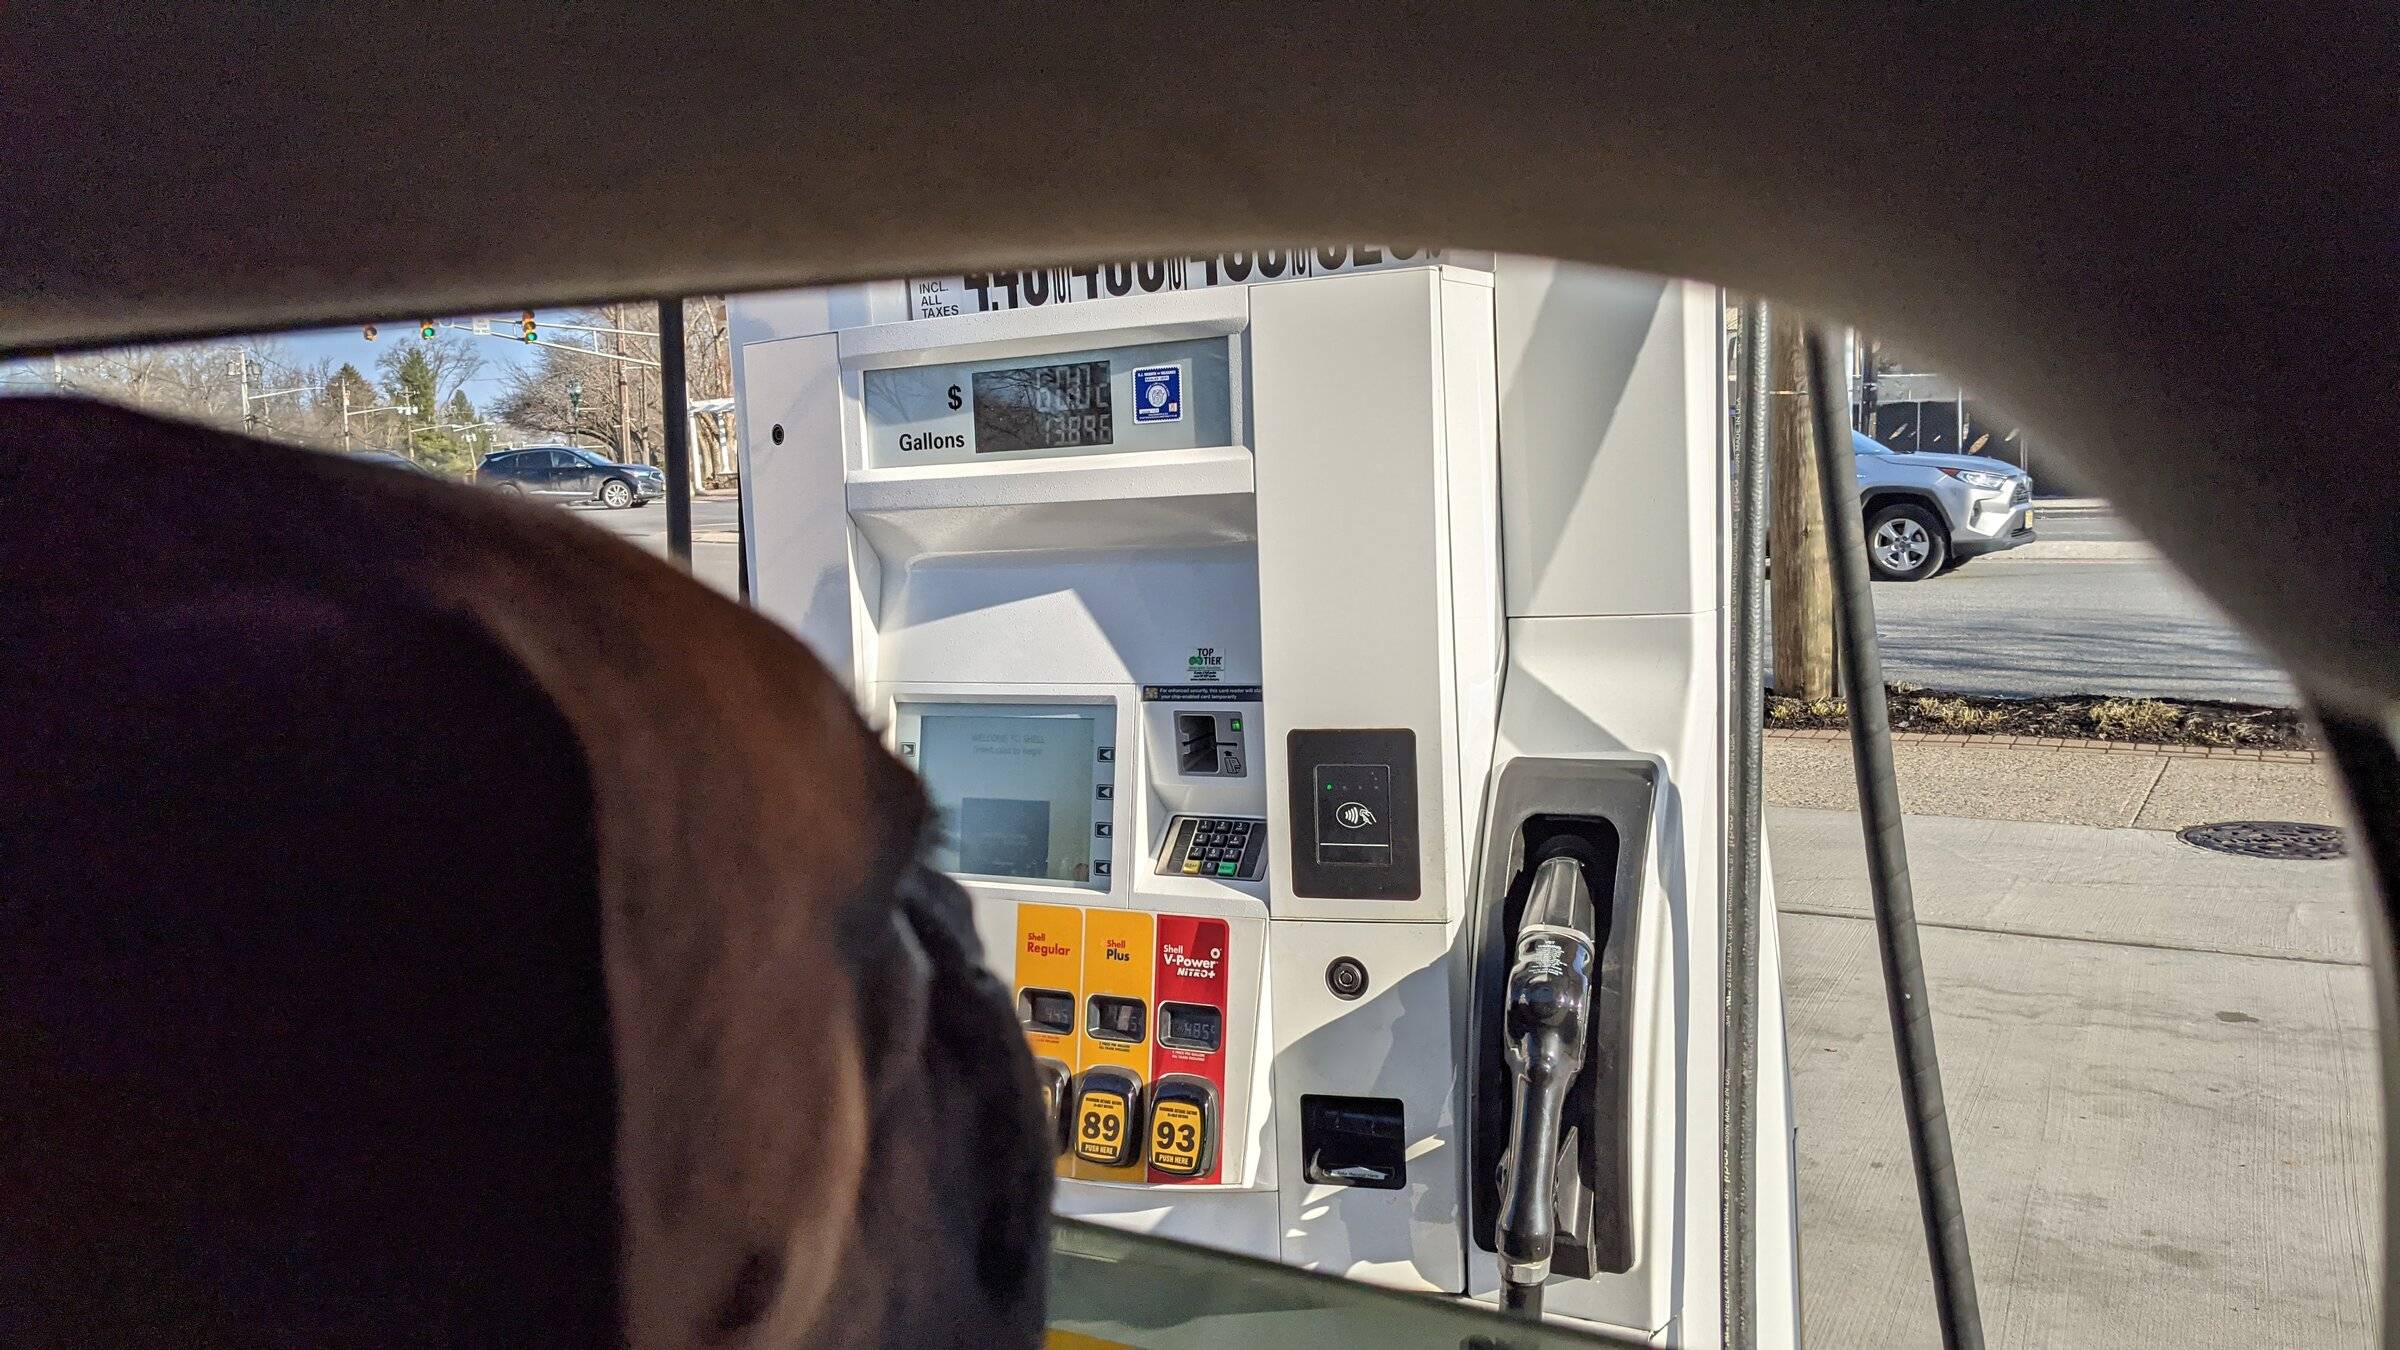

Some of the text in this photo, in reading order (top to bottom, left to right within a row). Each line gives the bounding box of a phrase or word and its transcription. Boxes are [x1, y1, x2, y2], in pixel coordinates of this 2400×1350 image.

[919, 282, 949, 295] INCL.
[921, 295, 943, 306] ALL
[922, 305, 959, 319] TAXES
[948, 384, 963, 411] $
[899, 432, 965, 451] Gallons
[1197, 648, 1214, 656] TOP
[1204, 656, 1221, 665] TIER
[1028, 932, 1046, 942] Shell
[1027, 942, 1071, 957] Regular
[1106, 939, 1126, 949] Shell
[1163, 944, 1183, 954] Shell
[1106, 949, 1130, 962] Plus
[1163, 953, 1216, 969] V-Power
[1082, 1111, 1120, 1141] 89
[1156, 1121, 1195, 1152] 93
[1085, 1143, 1113, 1155] PUSH HERE
[1158, 1153, 1189, 1165] PUSH HERE
